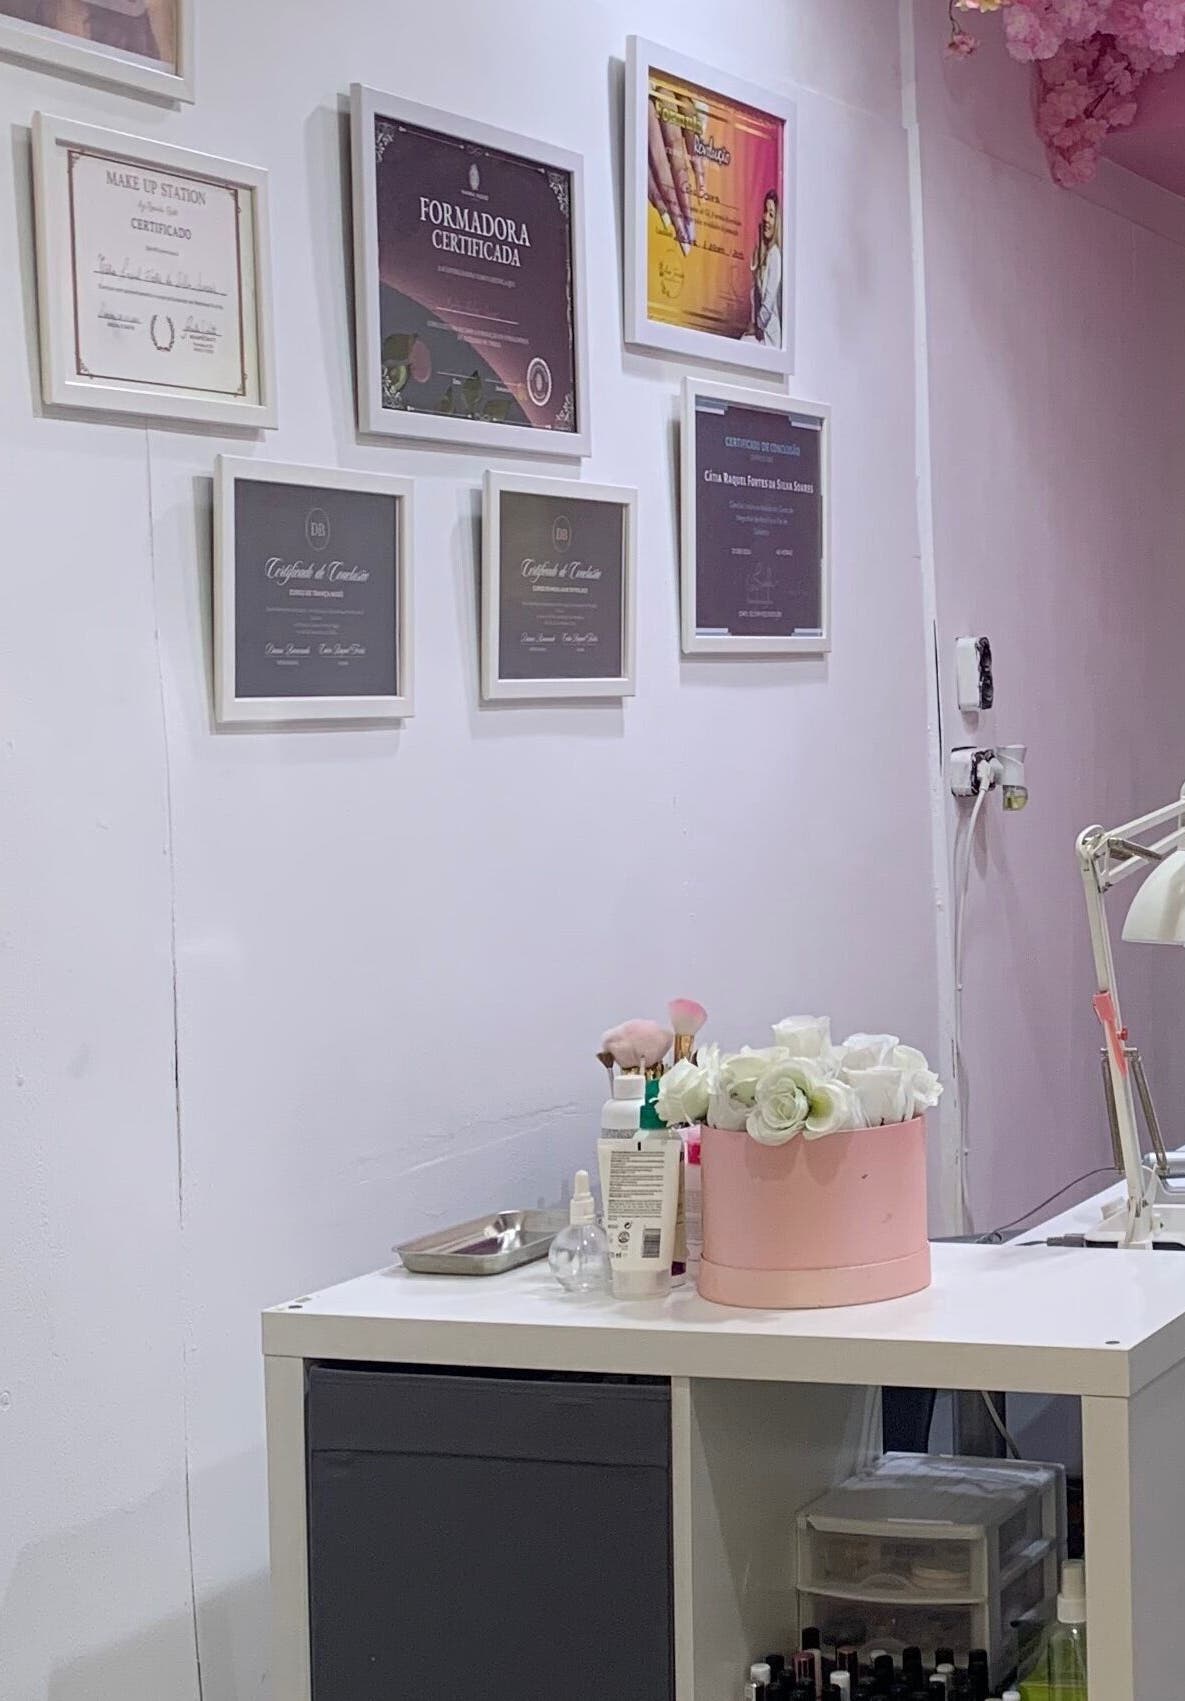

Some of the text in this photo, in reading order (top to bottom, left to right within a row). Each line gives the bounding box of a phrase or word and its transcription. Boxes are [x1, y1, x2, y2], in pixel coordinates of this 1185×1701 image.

[106, 169, 207, 206] MAKE UP STATION
[130, 217, 192, 240] CERTIFICADO
[419, 196, 532, 247] FORMADORA
[432, 228, 521, 267] CERTIFICADA
